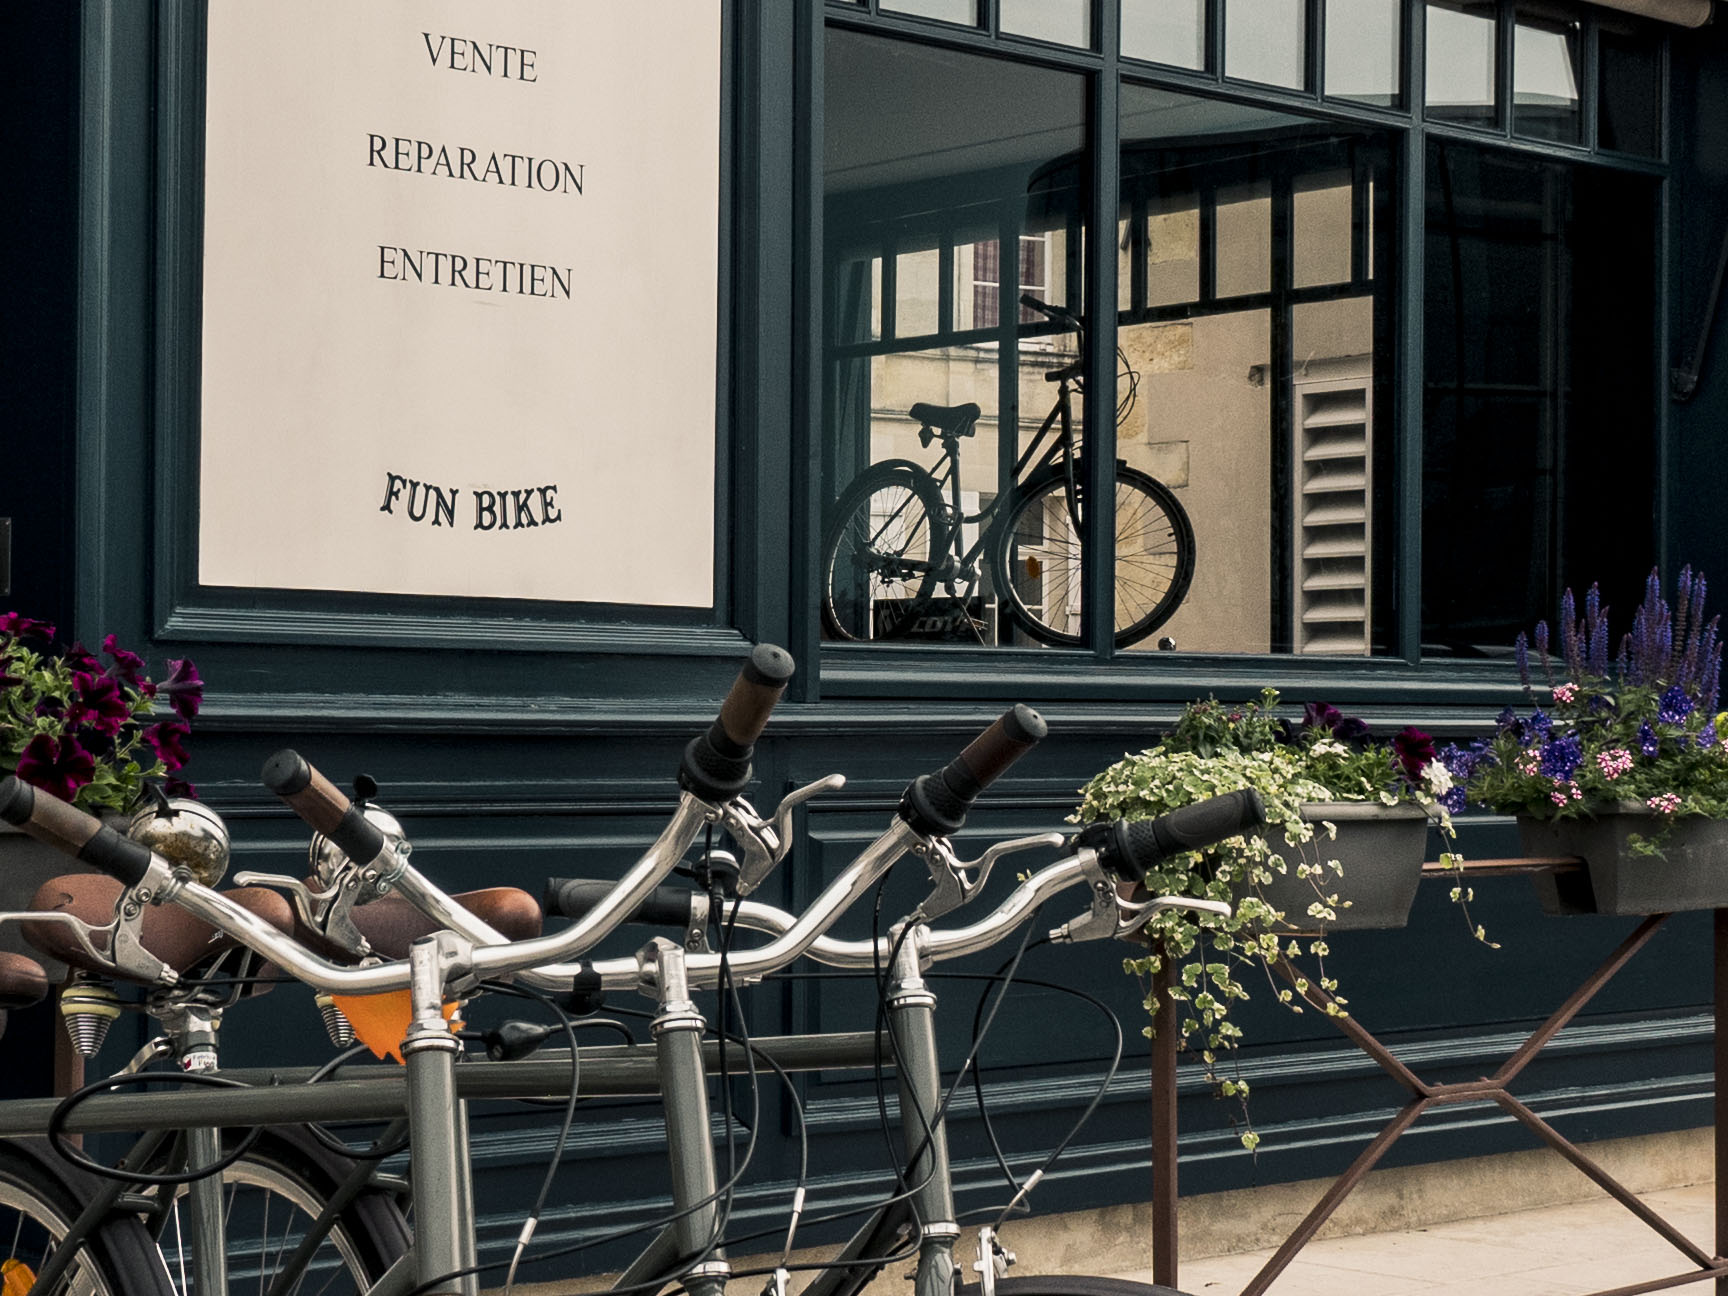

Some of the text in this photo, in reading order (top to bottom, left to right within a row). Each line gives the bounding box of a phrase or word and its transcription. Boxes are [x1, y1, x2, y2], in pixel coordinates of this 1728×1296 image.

[422, 32, 538, 83] VENTE
[367, 133, 585, 196] REPARATION
[377, 245, 573, 300] ENTRETIEN
[379, 471, 563, 532] FUN BIKE
